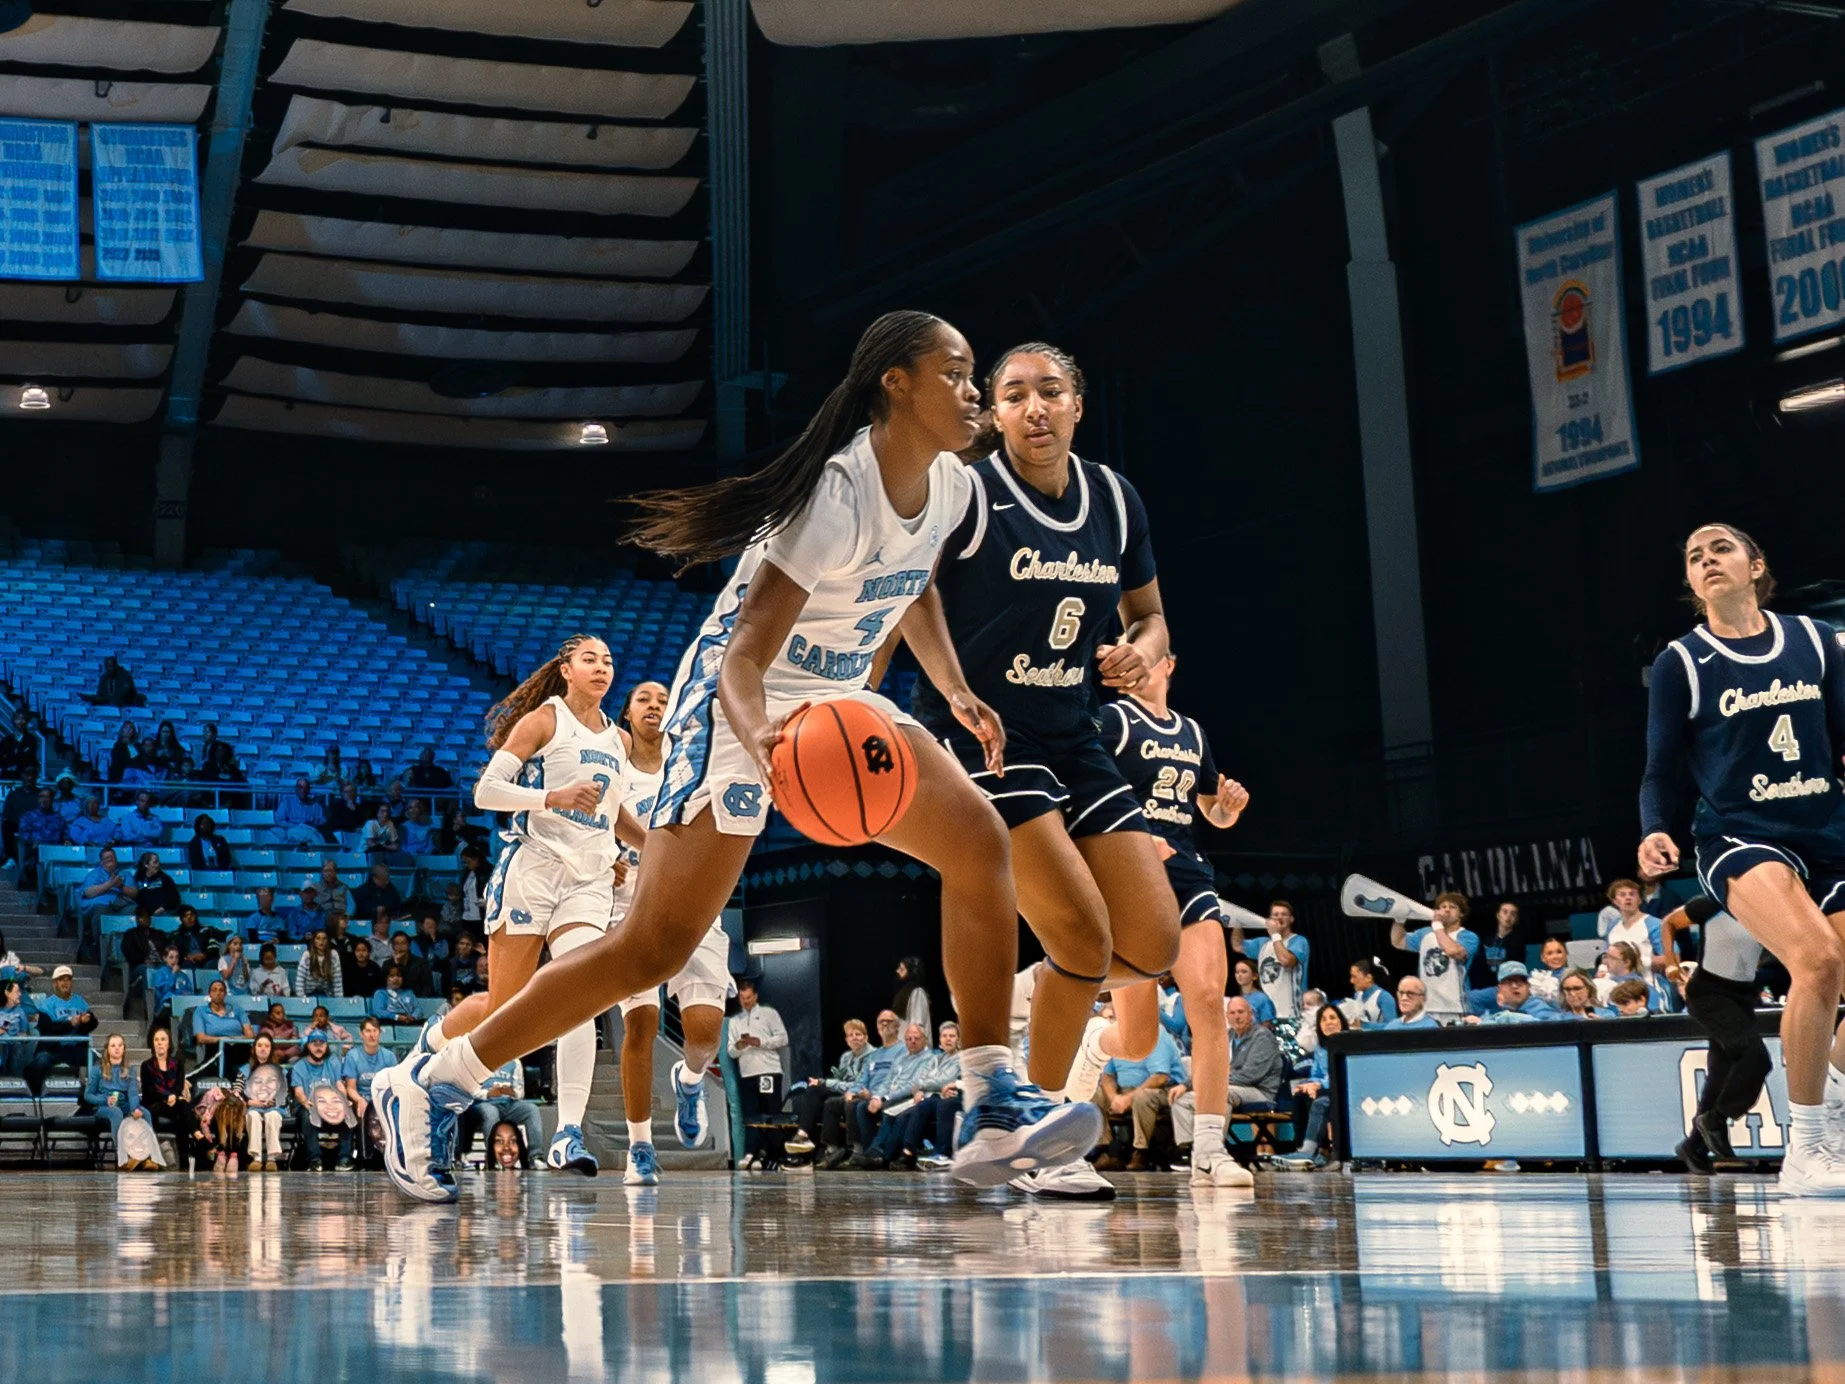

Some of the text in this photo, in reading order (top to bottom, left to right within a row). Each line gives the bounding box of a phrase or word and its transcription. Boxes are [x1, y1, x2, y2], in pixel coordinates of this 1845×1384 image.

[1764, 154, 1845, 201] BASKETBAL
[1775, 255, 1845, 326] 200
[1656, 292, 1732, 357] 1994
[1010, 546, 1119, 584] Charleston
[853, 605, 897, 647] 4
[1048, 596, 1086, 650] 6
[786, 633, 876, 682] CAROLI
[1718, 678, 1822, 718] Charleston
[1140, 738, 1202, 767] Charleston
[1767, 713, 1801, 762] 4
[1152, 765, 1196, 803] 20
[1417, 837, 1602, 902] CAROLINA
